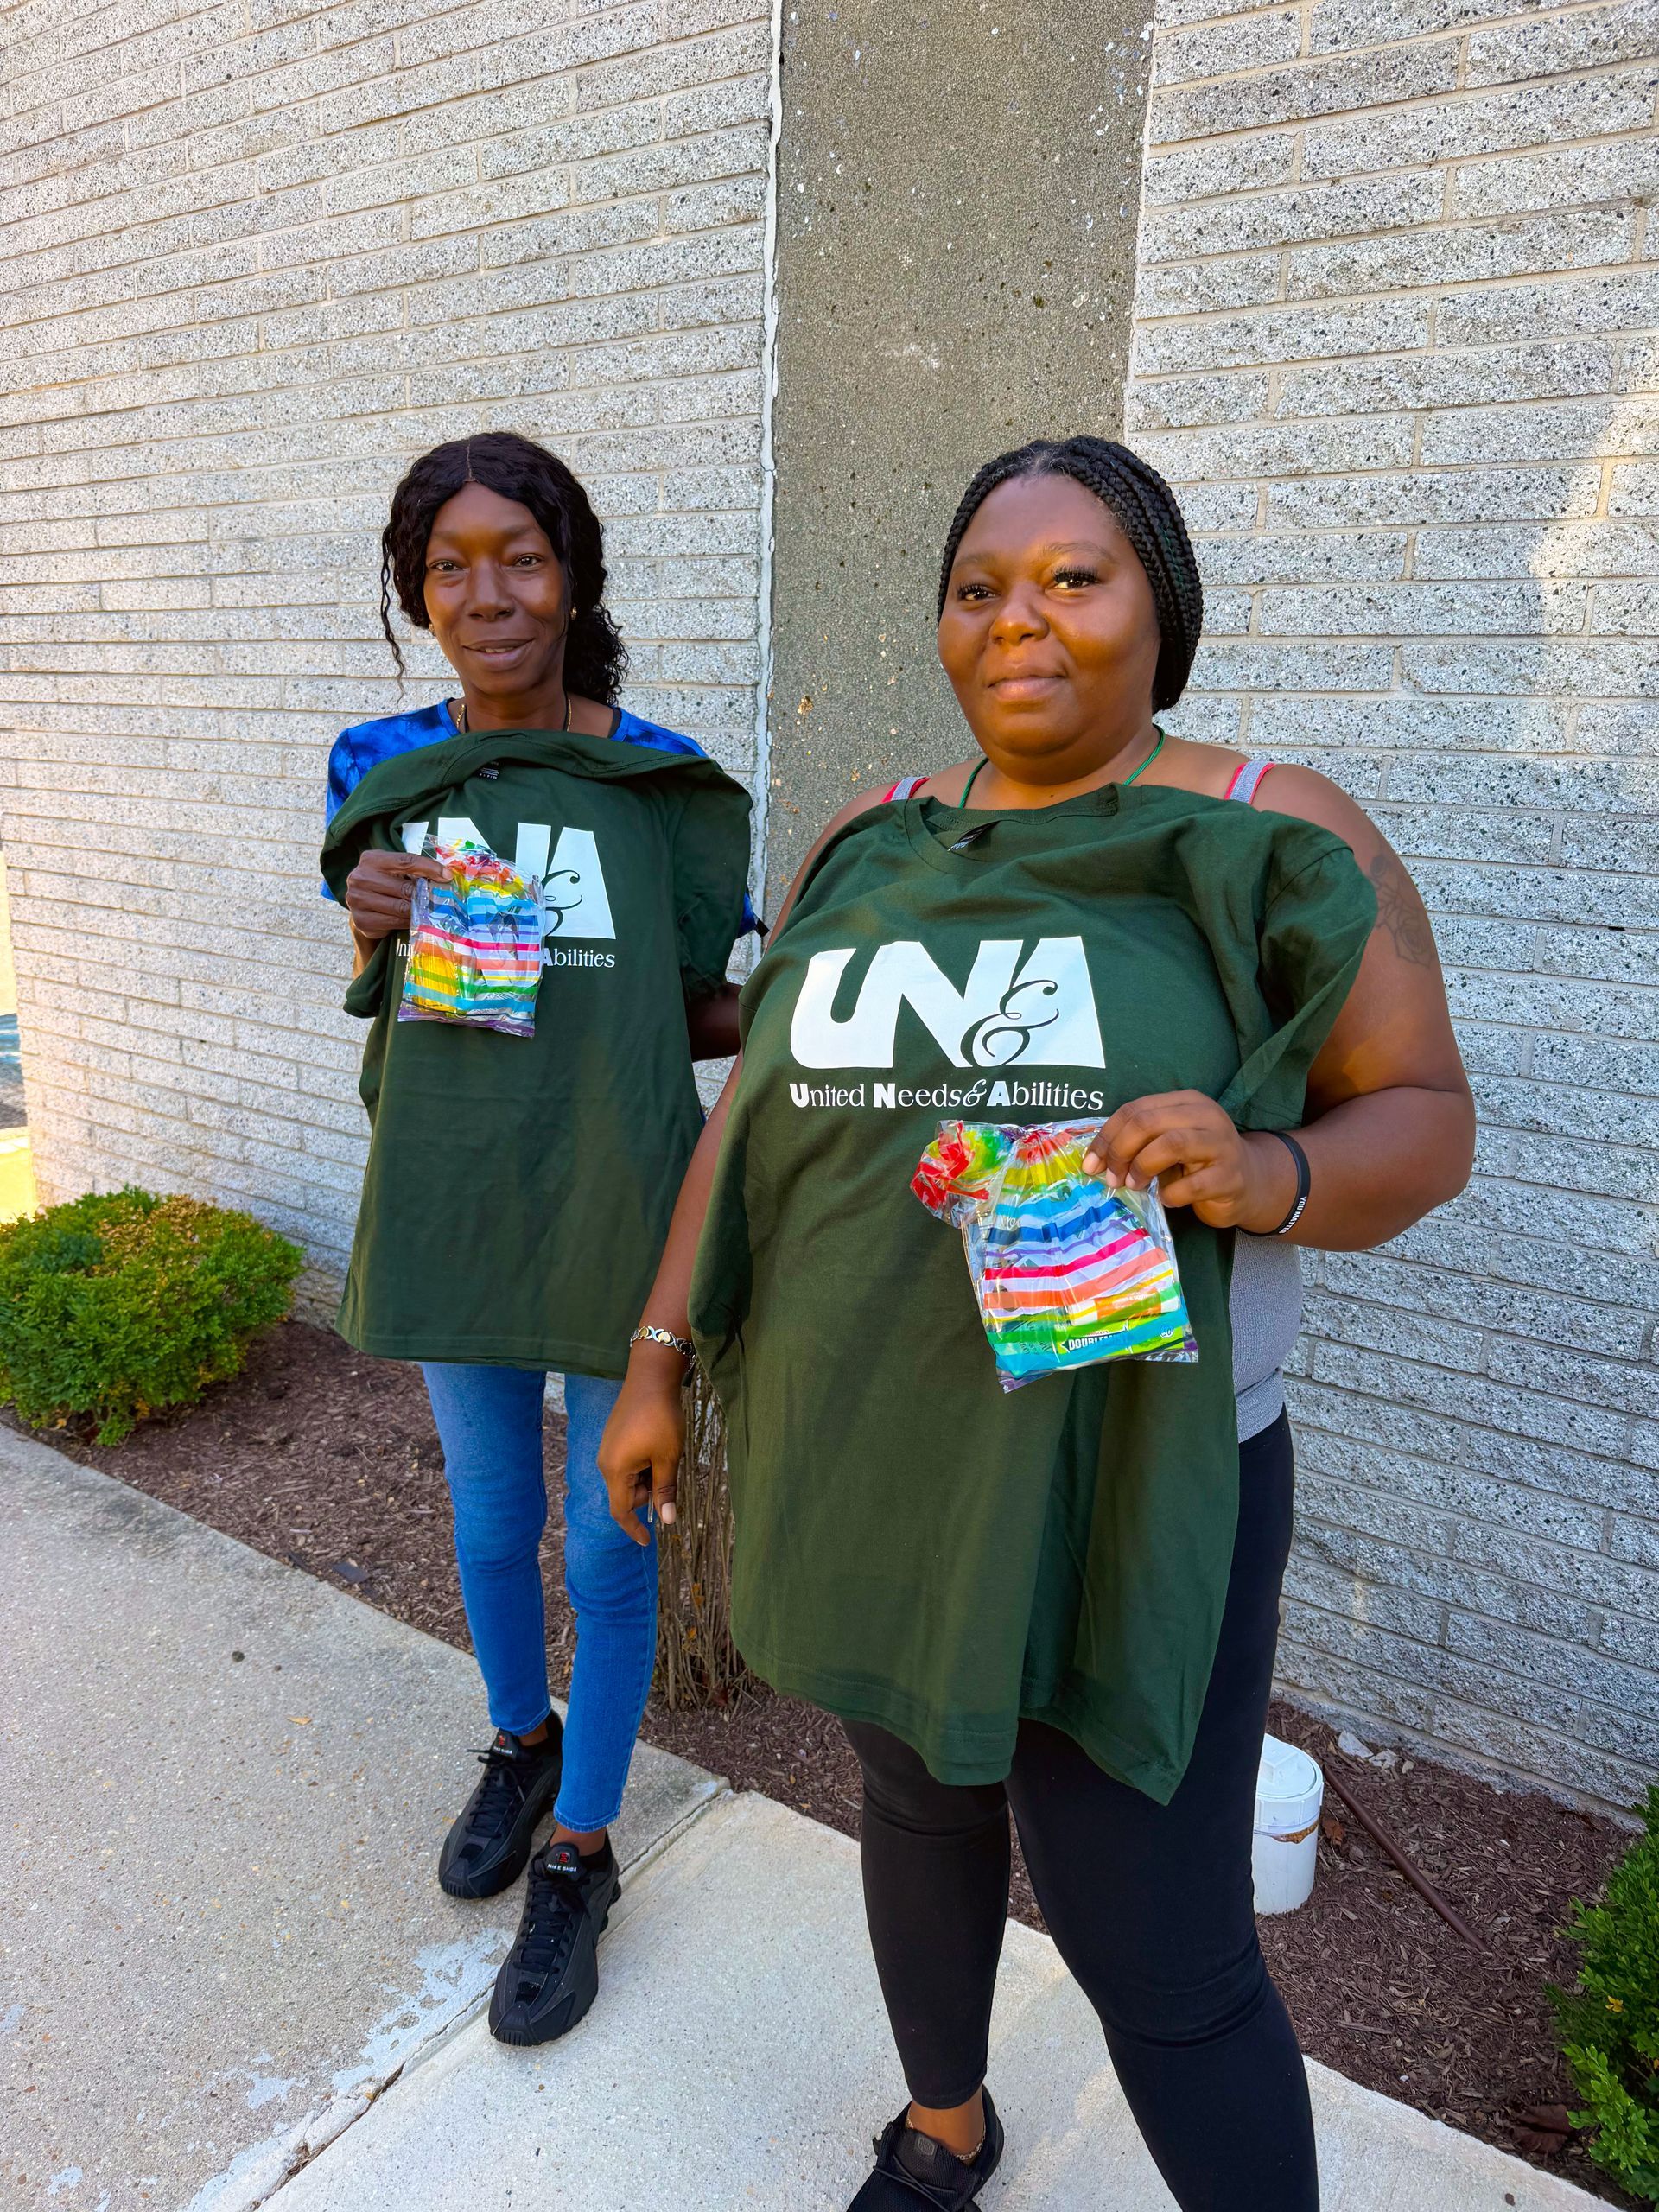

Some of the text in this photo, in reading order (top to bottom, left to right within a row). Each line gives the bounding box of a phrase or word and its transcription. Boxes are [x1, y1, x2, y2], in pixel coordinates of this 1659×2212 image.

[543, 947, 615, 968] Abilities
[790, 1084, 865, 1109] United
[1279, 1196, 1306, 1234] YOU MATTER
